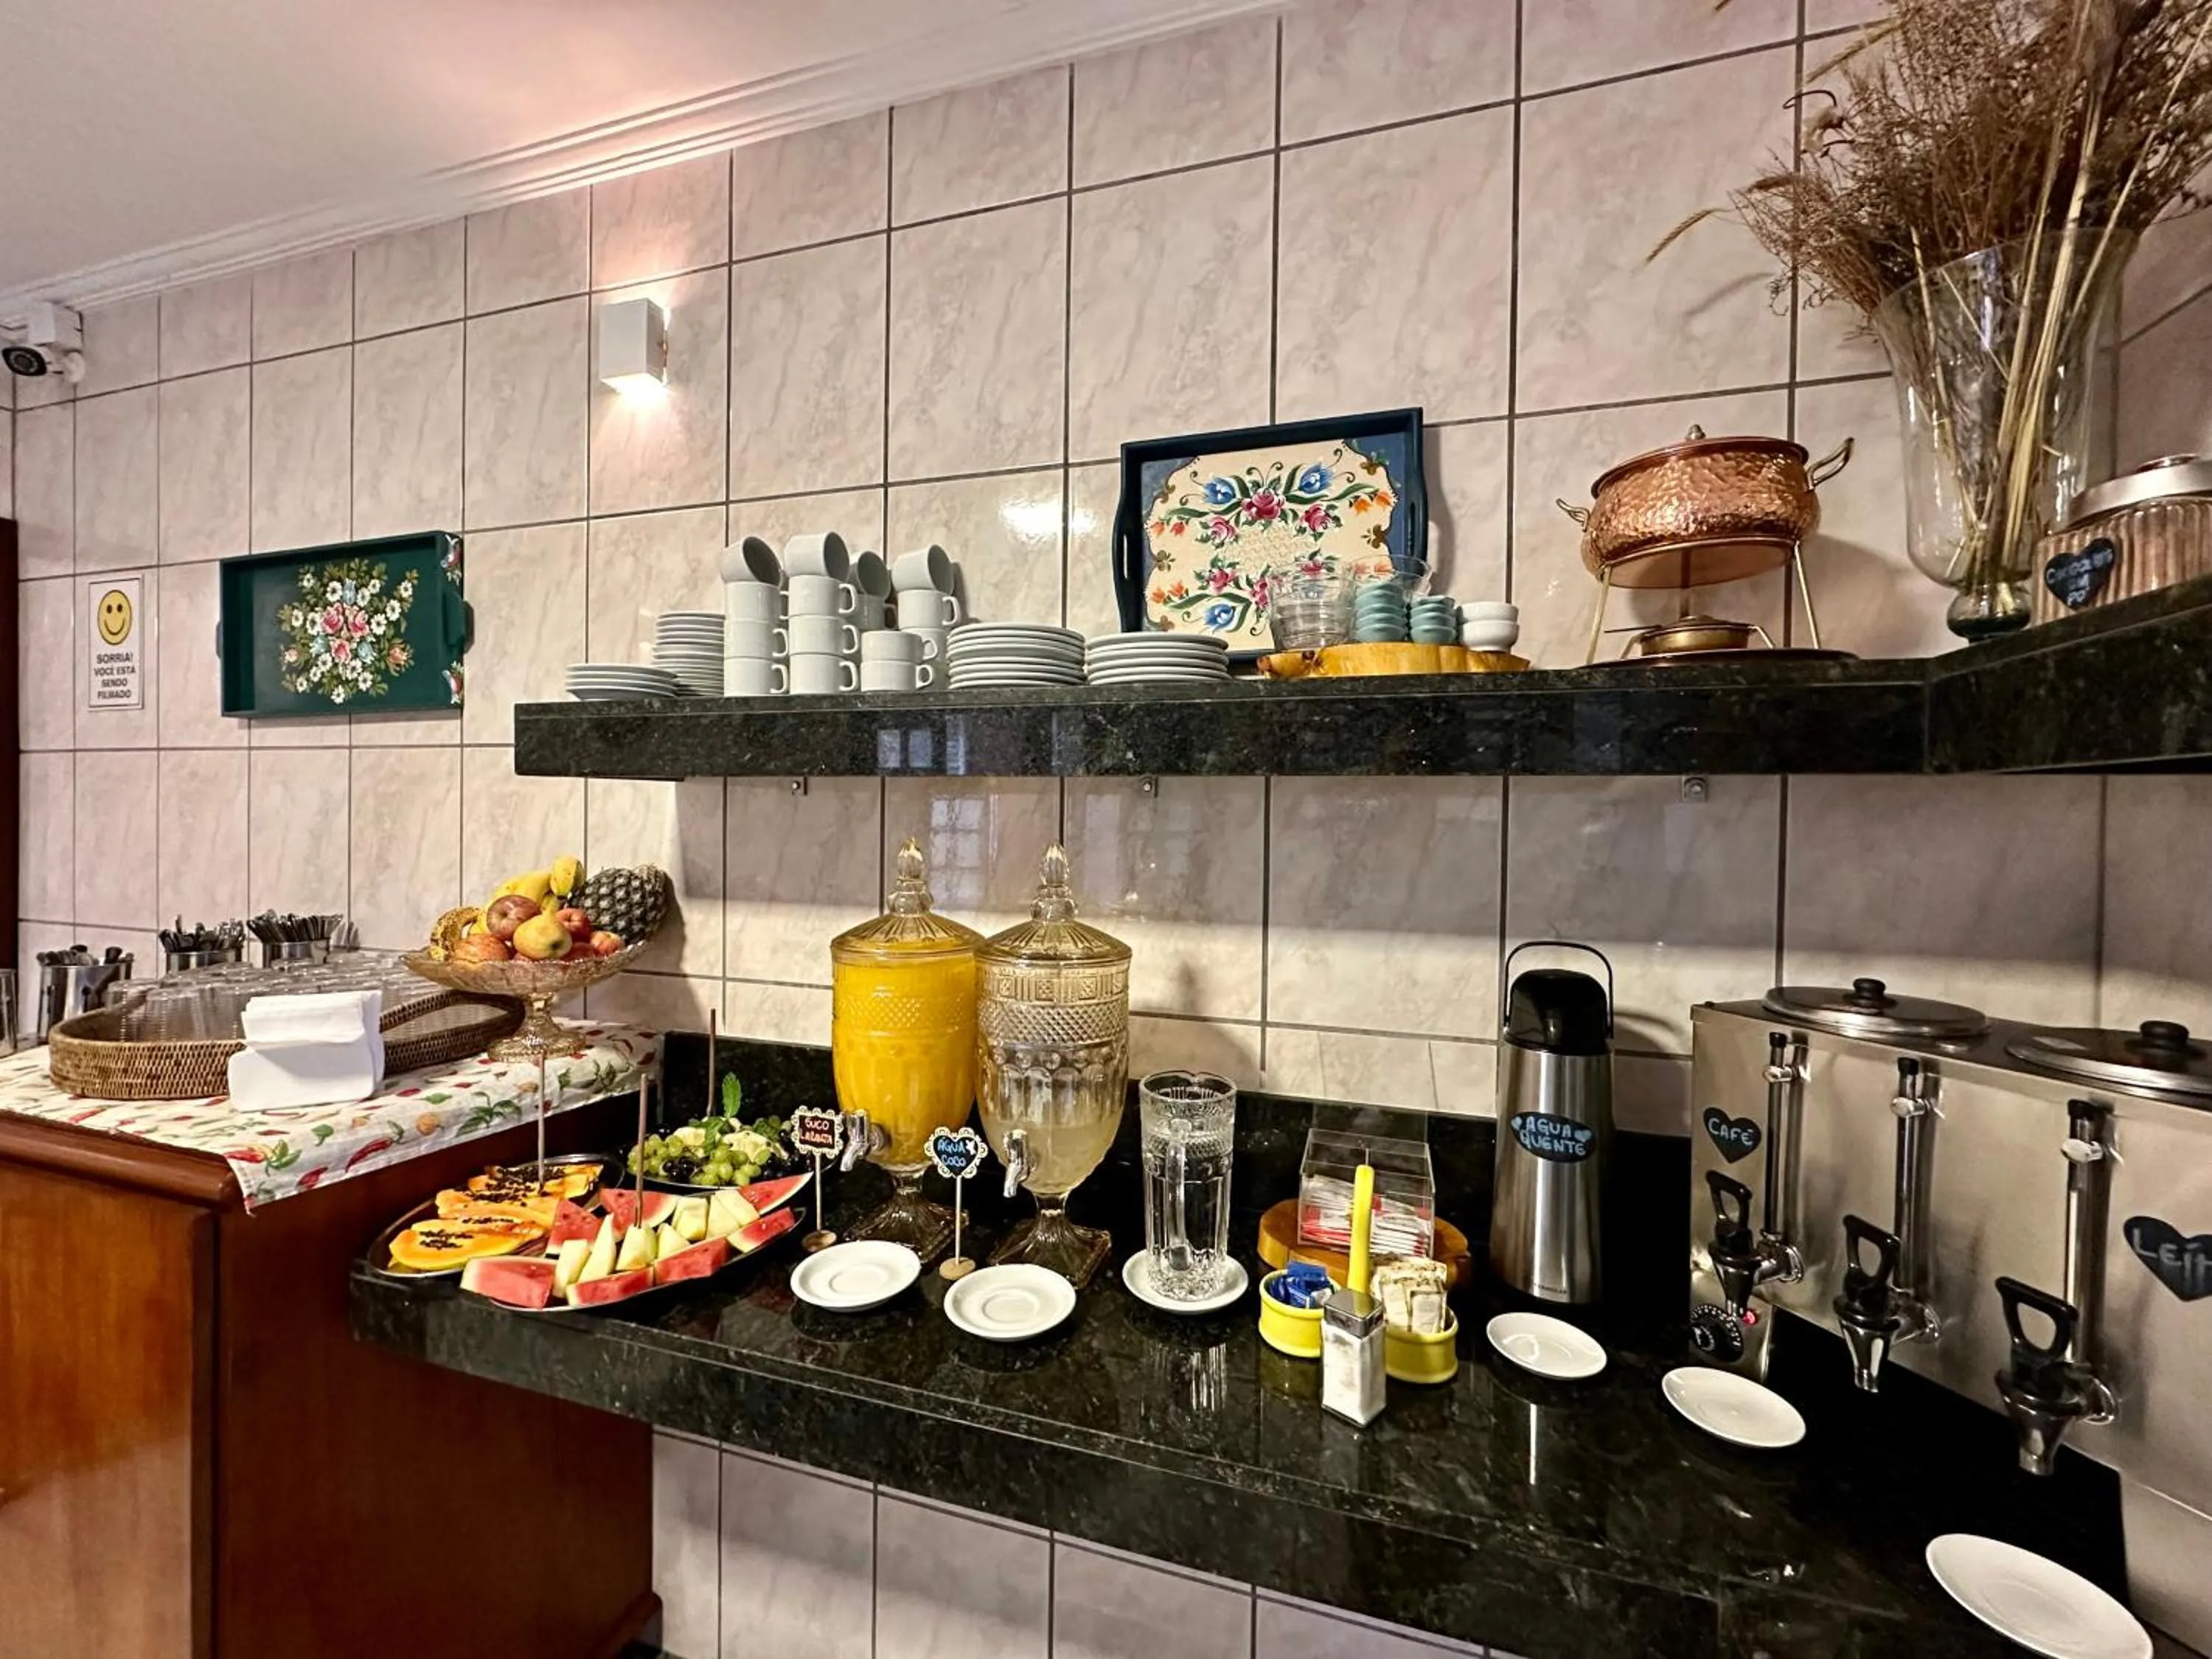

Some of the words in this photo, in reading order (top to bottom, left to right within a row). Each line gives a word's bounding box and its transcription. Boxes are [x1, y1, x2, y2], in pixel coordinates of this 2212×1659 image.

[102, 678, 127, 687] SENDO
[97, 690, 131, 699] FILMADO
[1708, 1117, 1754, 1146] CAFÉ
[1520, 1129, 1587, 1156] QUENTE
